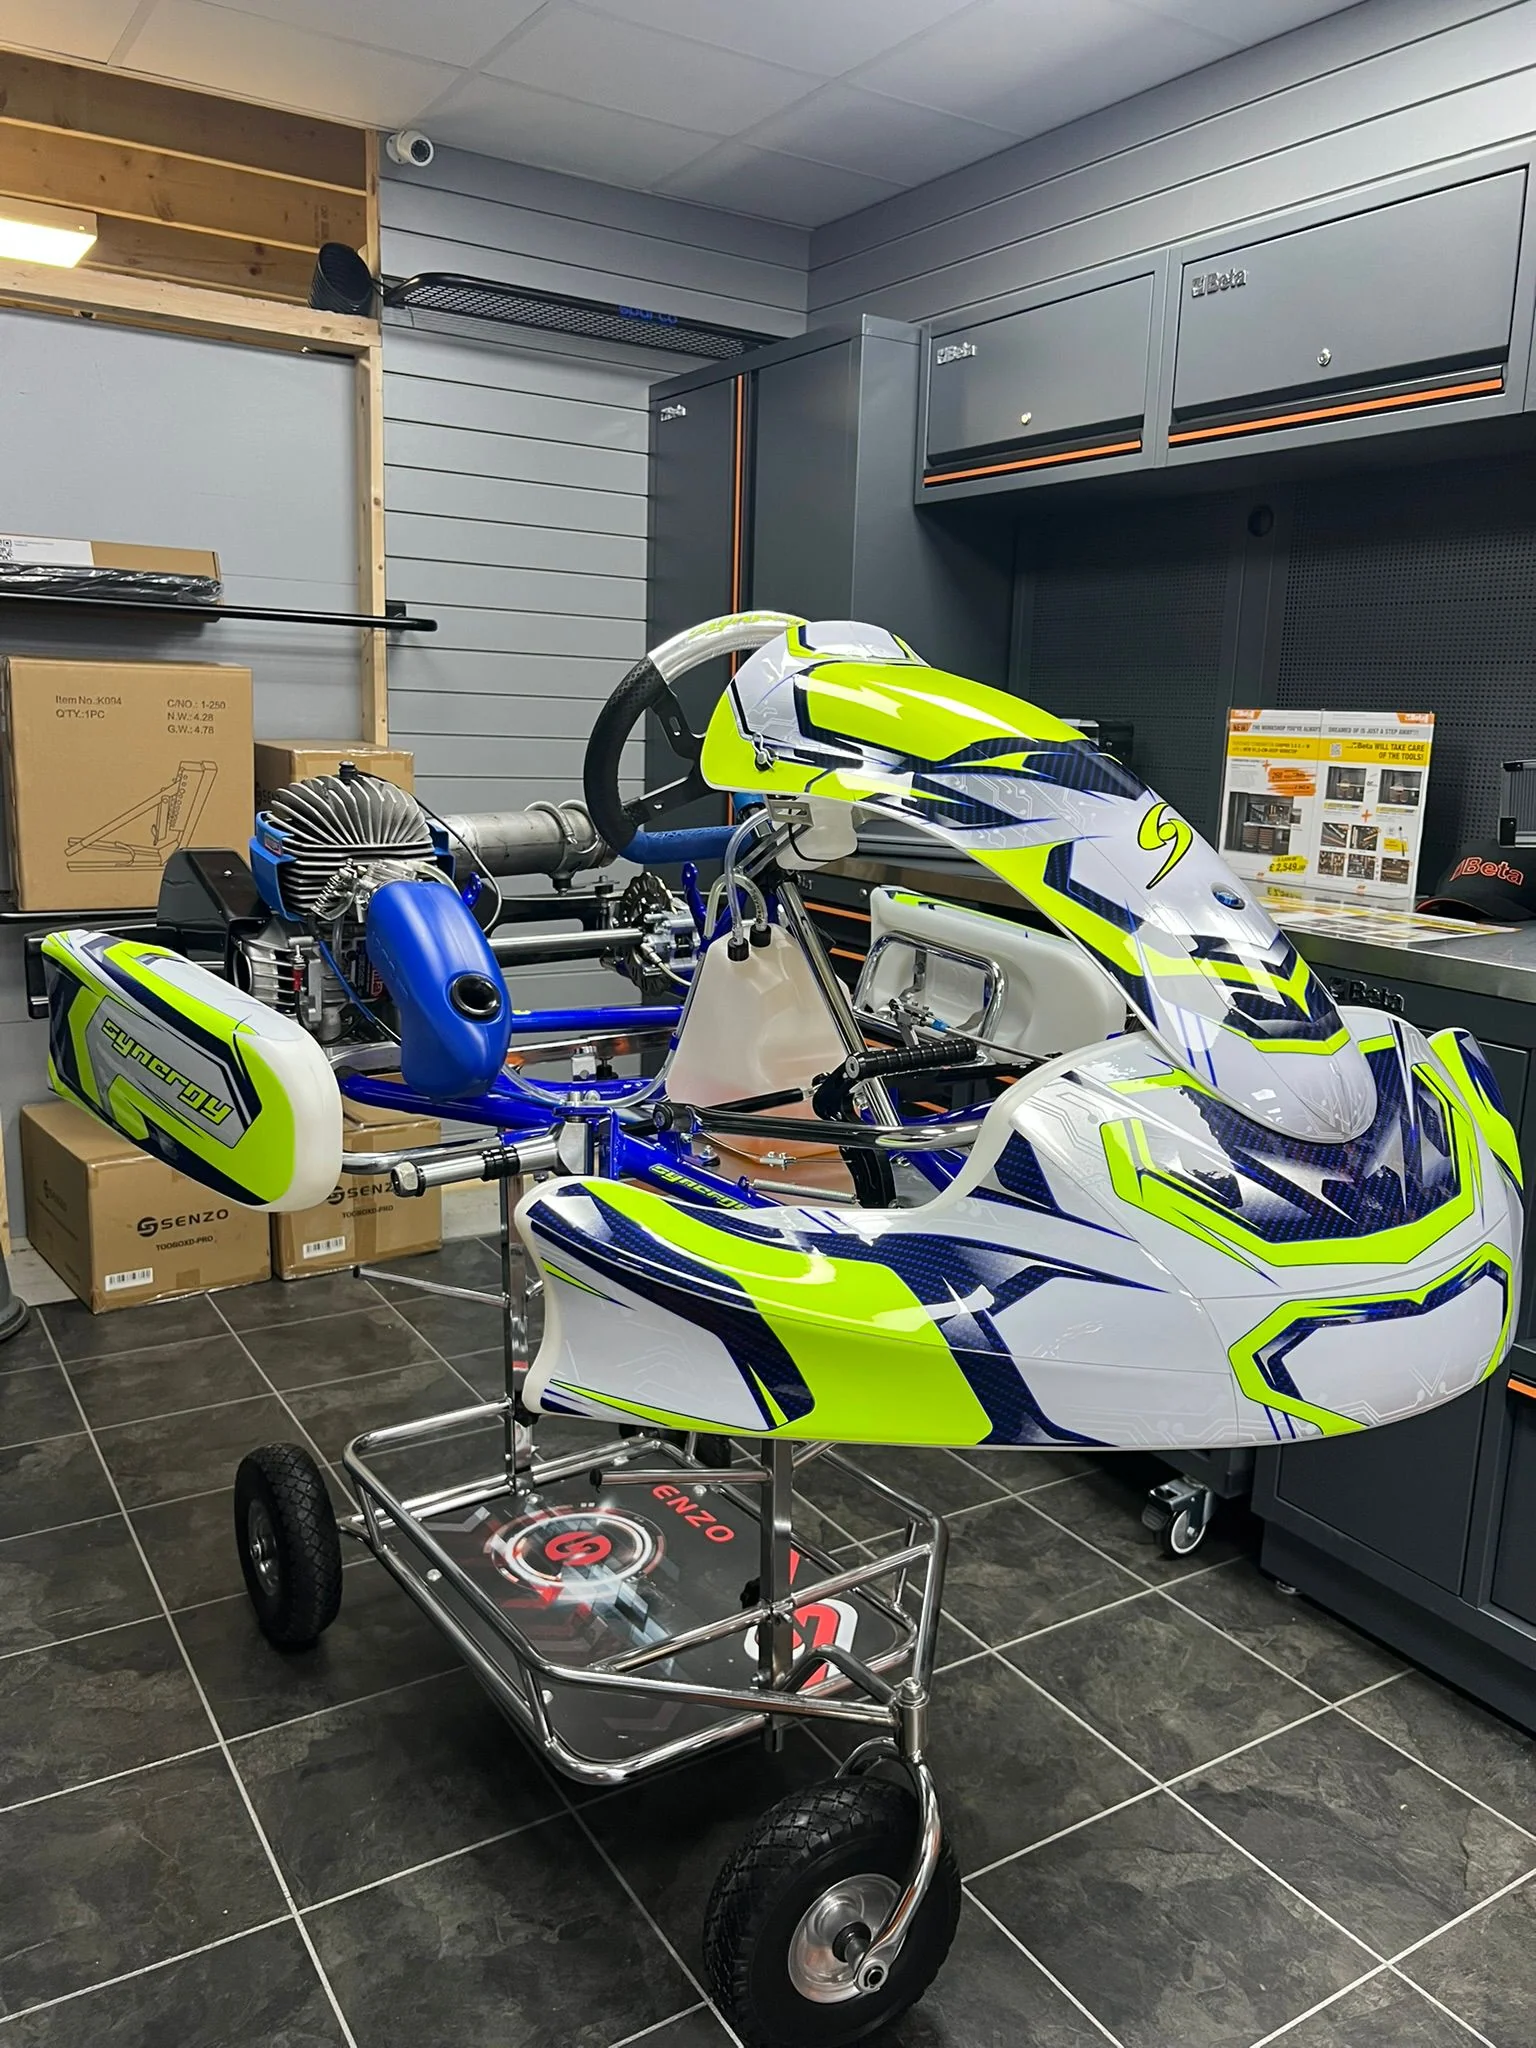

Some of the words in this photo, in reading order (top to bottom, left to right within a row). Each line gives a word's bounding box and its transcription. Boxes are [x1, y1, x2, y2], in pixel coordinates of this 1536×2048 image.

[1207, 268, 1247, 296] Beta
[194, 725, 214, 735] 4.78
[1374, 743, 1389, 751] WILL
[1390, 743, 1406, 752] TAKE
[1407, 744, 1425, 753] CARE
[1378, 752, 1387, 760] OF
[1388, 752, 1400, 760] THE
[1401, 753, 1424, 761] TOOLS!
[1461, 856, 1524, 886] Beta
[101, 1018, 235, 1126] synergy
[346, 1182, 393, 1199] SENZ
[160, 1208, 229, 1230] SENZO
[652, 1484, 735, 1543] ENZO
